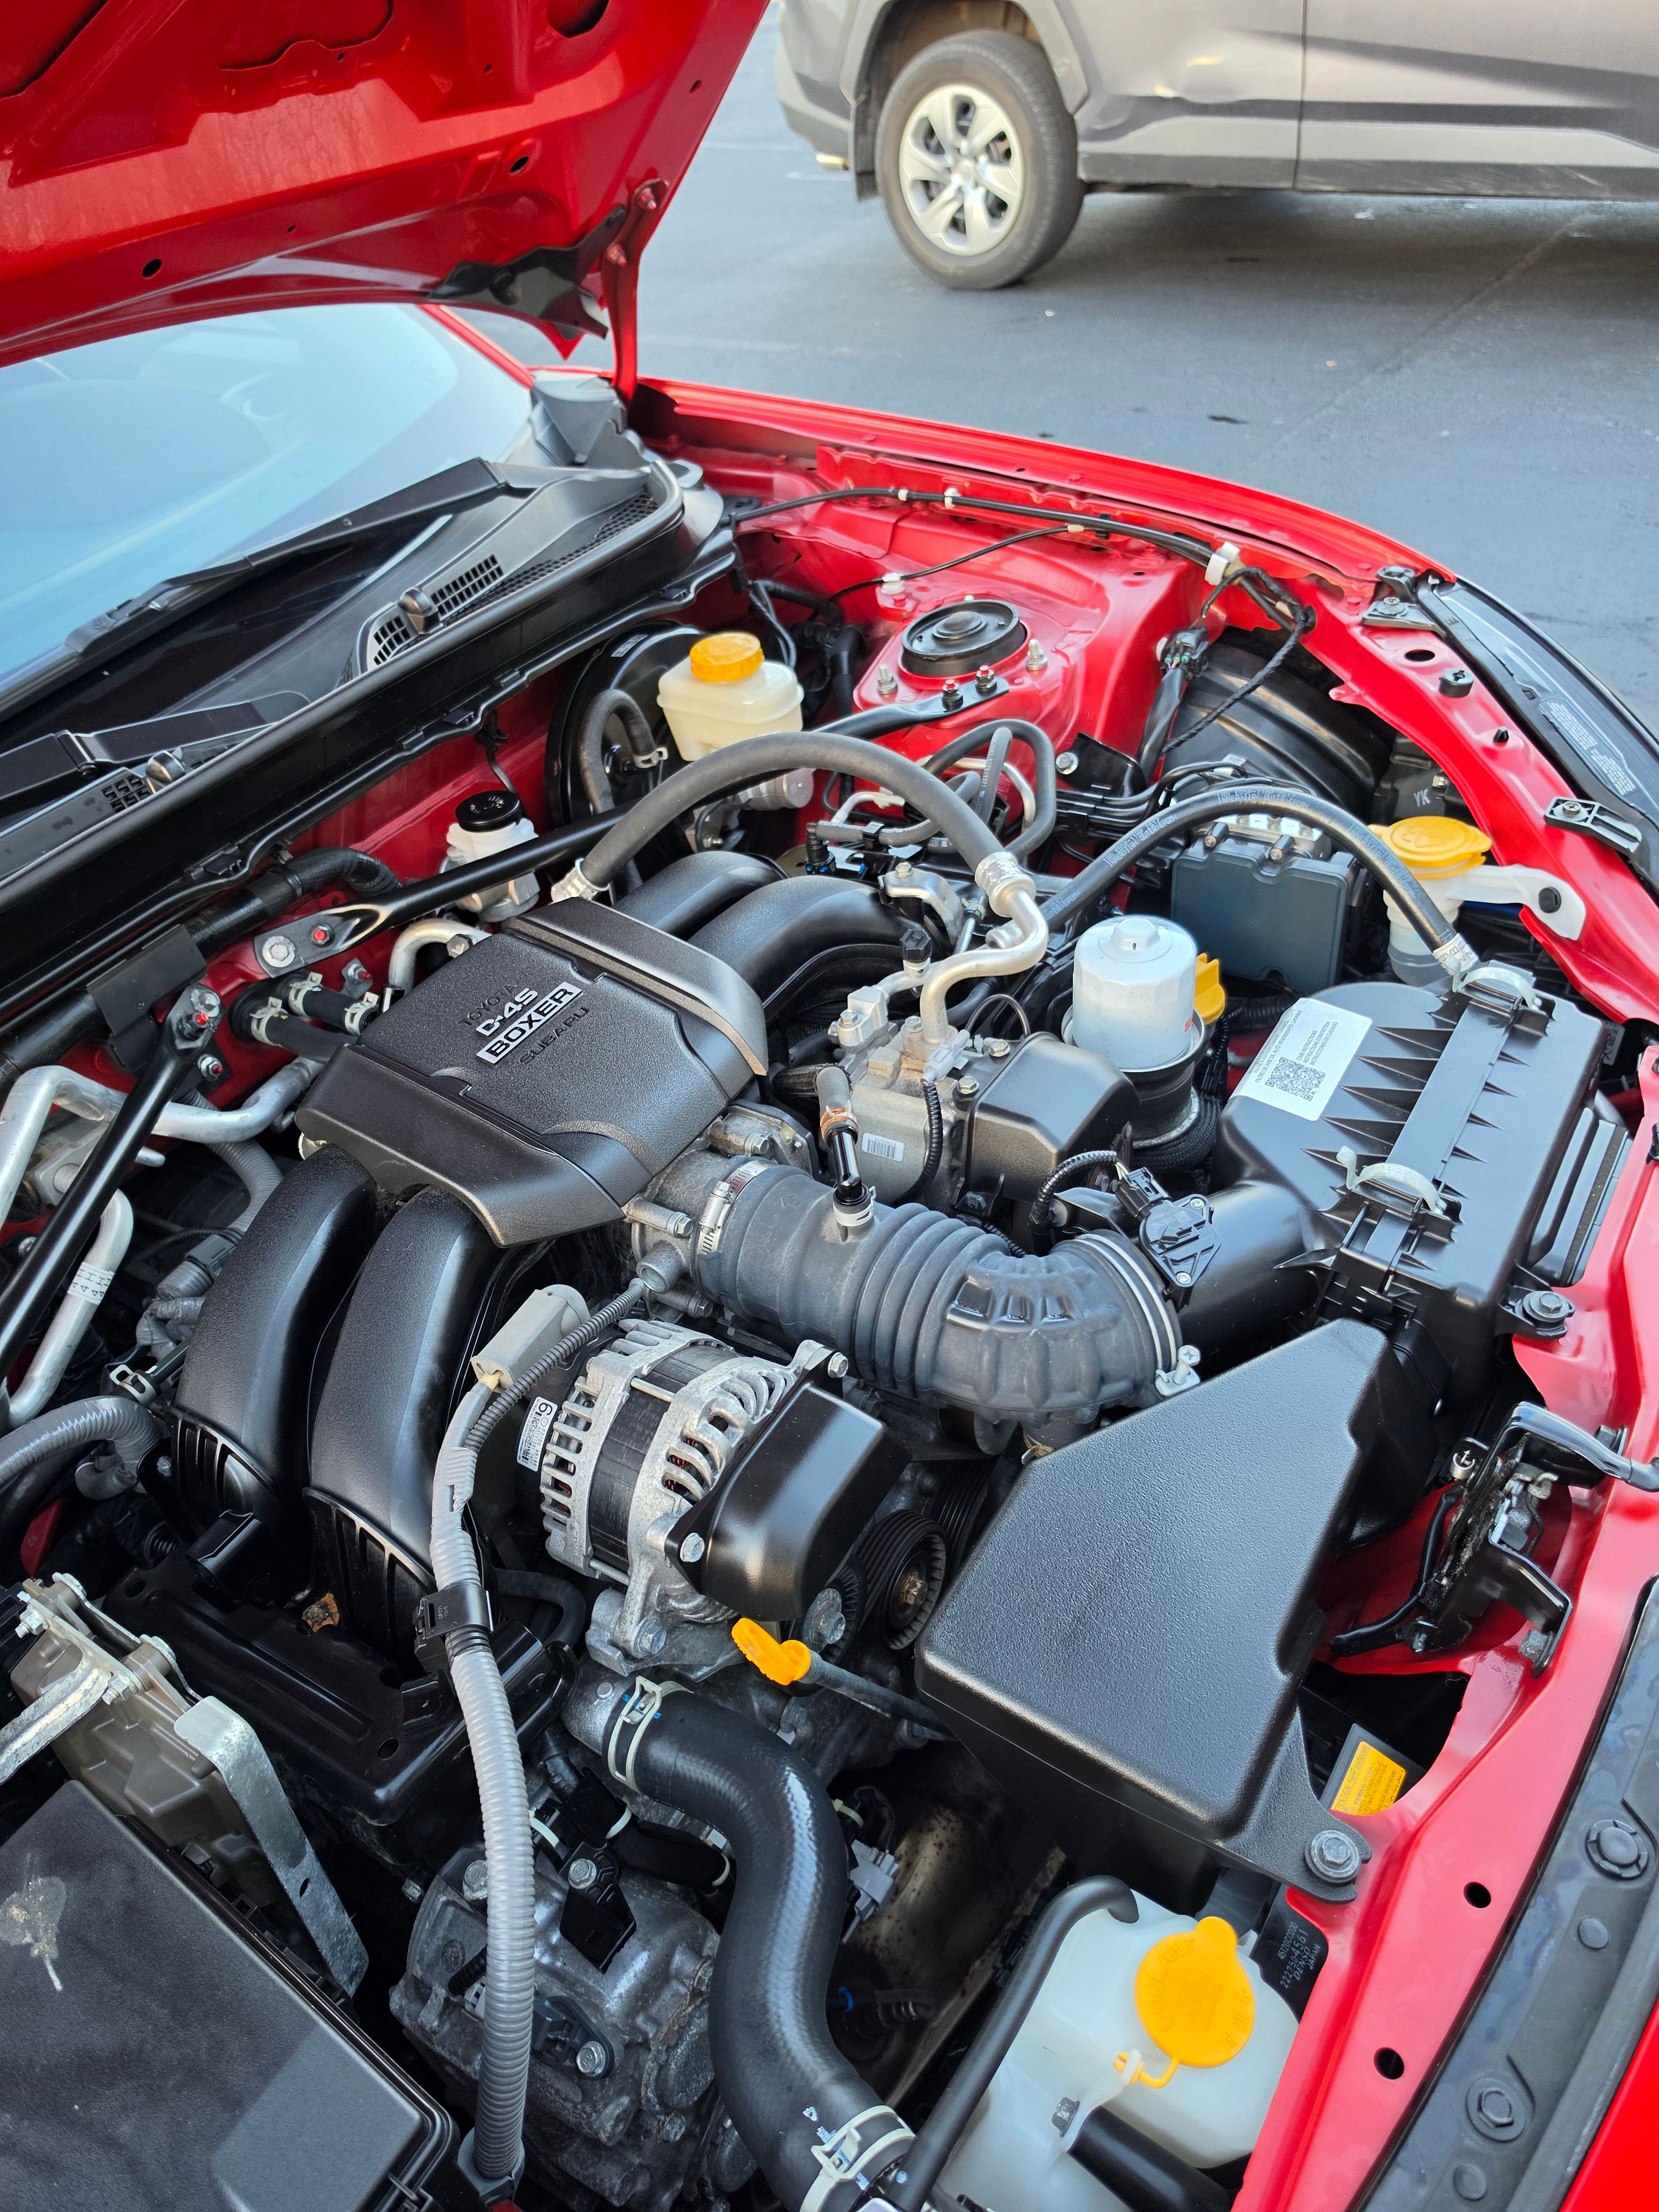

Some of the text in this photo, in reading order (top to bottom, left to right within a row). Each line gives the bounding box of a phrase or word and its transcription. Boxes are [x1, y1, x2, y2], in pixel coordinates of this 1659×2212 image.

[1412, 788, 1431, 807] YK
[904, 931, 926, 947] H
[458, 983, 518, 1026] TOYOTA
[476, 988, 538, 1036] D-4S
[1290, 1008, 1302, 1024] LAVABLE
[485, 988, 574, 1057] BOXER
[518, 1006, 589, 1065] SUBARU
[1277, 1022, 1294, 1046] RENDIMIENTO
[1269, 1052, 1276, 1060] DE
[1272, 1044, 1281, 1054] ALTO
[1296, 1029, 1318, 1061] CARE INSTRUCTIONS
[1302, 1020, 1331, 1064] INSTRUCTIONS D'ENTRETIEN
[1308, 1040, 1327, 1066] INSTRUCCIONES
[1326, 1020, 1338, 1037] CUIDADO
[1254, 1070, 1265, 1083] FILTRO
[1264, 1058, 1272, 1067] AIRE
[539, 1402, 552, 1415] 6
[1279, 1928, 1309, 1989] 222750-4561
[1292, 1945, 1311, 1981] DENSO
[1305, 1942, 1321, 1970] JAPAN
[1146, 1939, 1194, 2031] COOLANT
